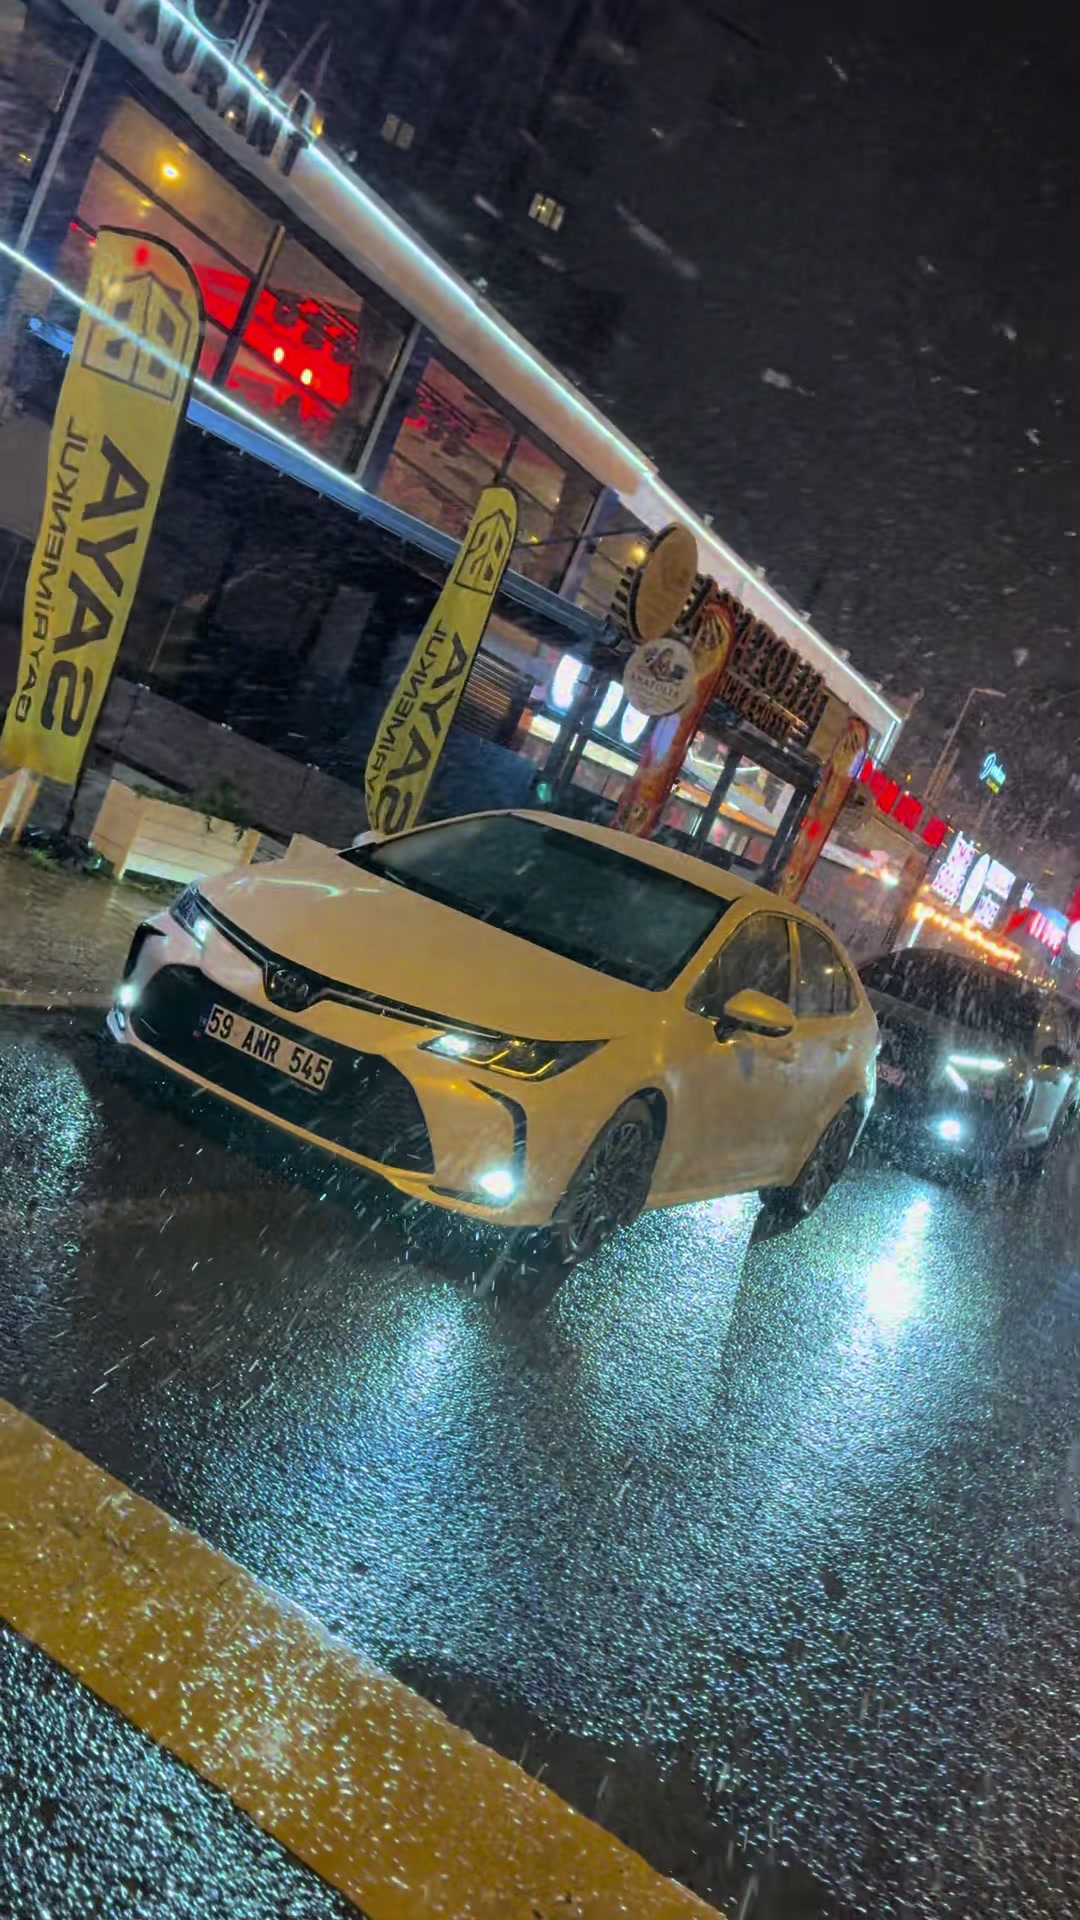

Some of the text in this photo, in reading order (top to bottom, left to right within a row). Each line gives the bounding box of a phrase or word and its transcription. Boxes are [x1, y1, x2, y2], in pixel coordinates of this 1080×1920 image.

[208, 1008, 329, 1085] 59 ANR 545
